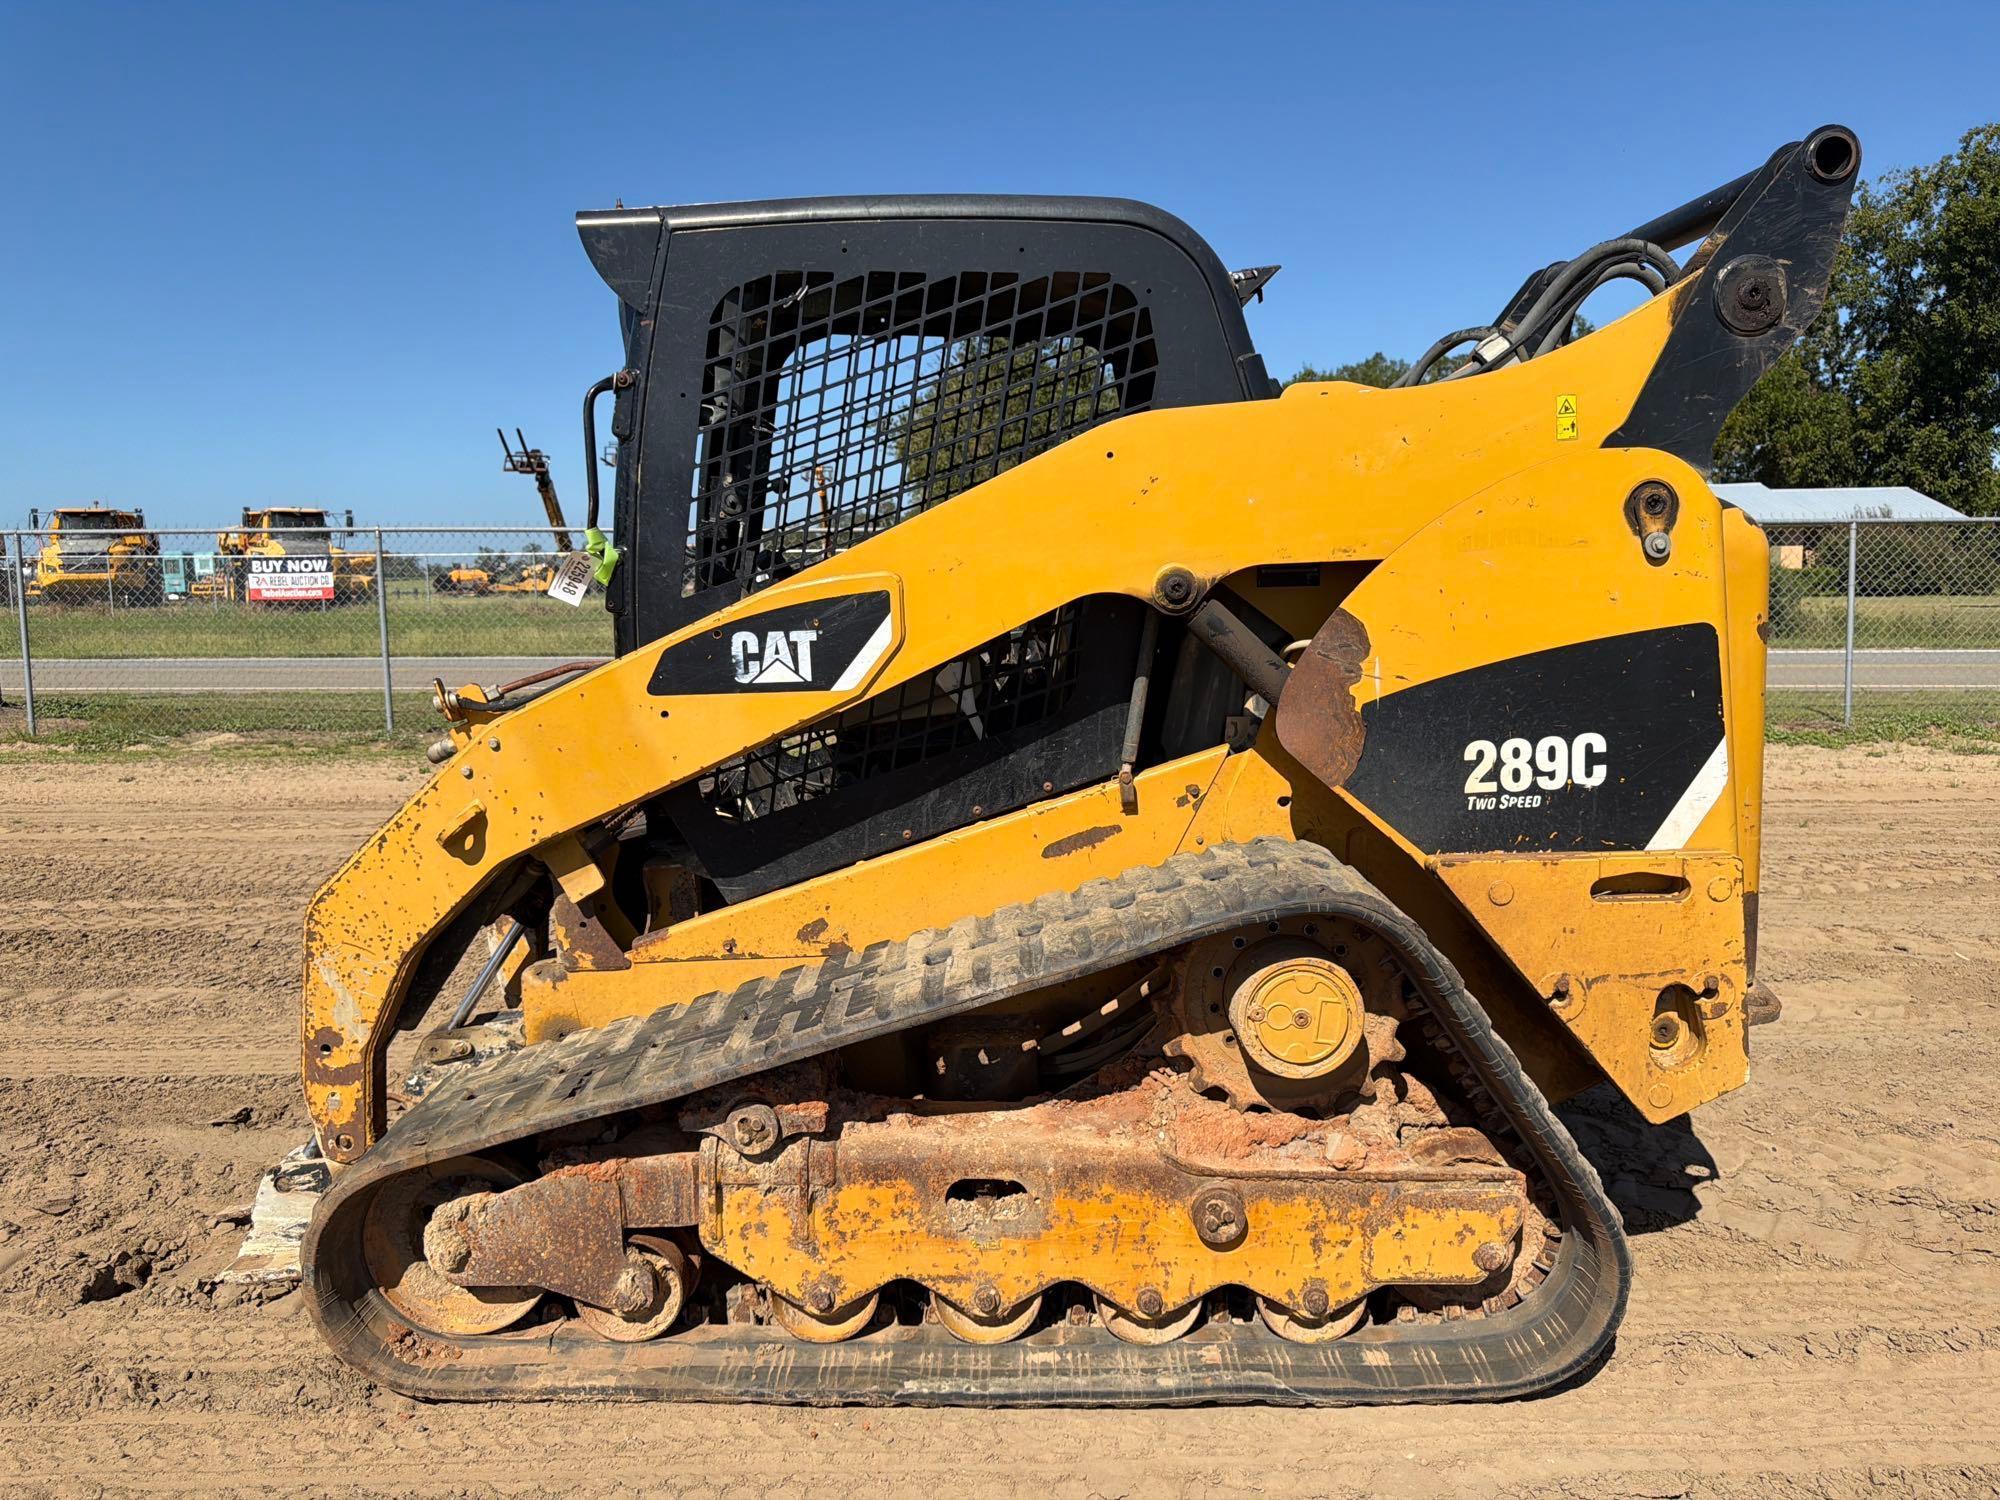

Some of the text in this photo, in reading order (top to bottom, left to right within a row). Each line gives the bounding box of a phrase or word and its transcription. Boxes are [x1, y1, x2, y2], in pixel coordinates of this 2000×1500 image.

[252, 559, 328, 573] BUY NOW
[269, 576, 289, 586] REBEL
[291, 575, 319, 586] AUCTION
[562, 561, 592, 596] 225948
[731, 630, 818, 684] CAT
[1463, 732, 1607, 793] 289C
